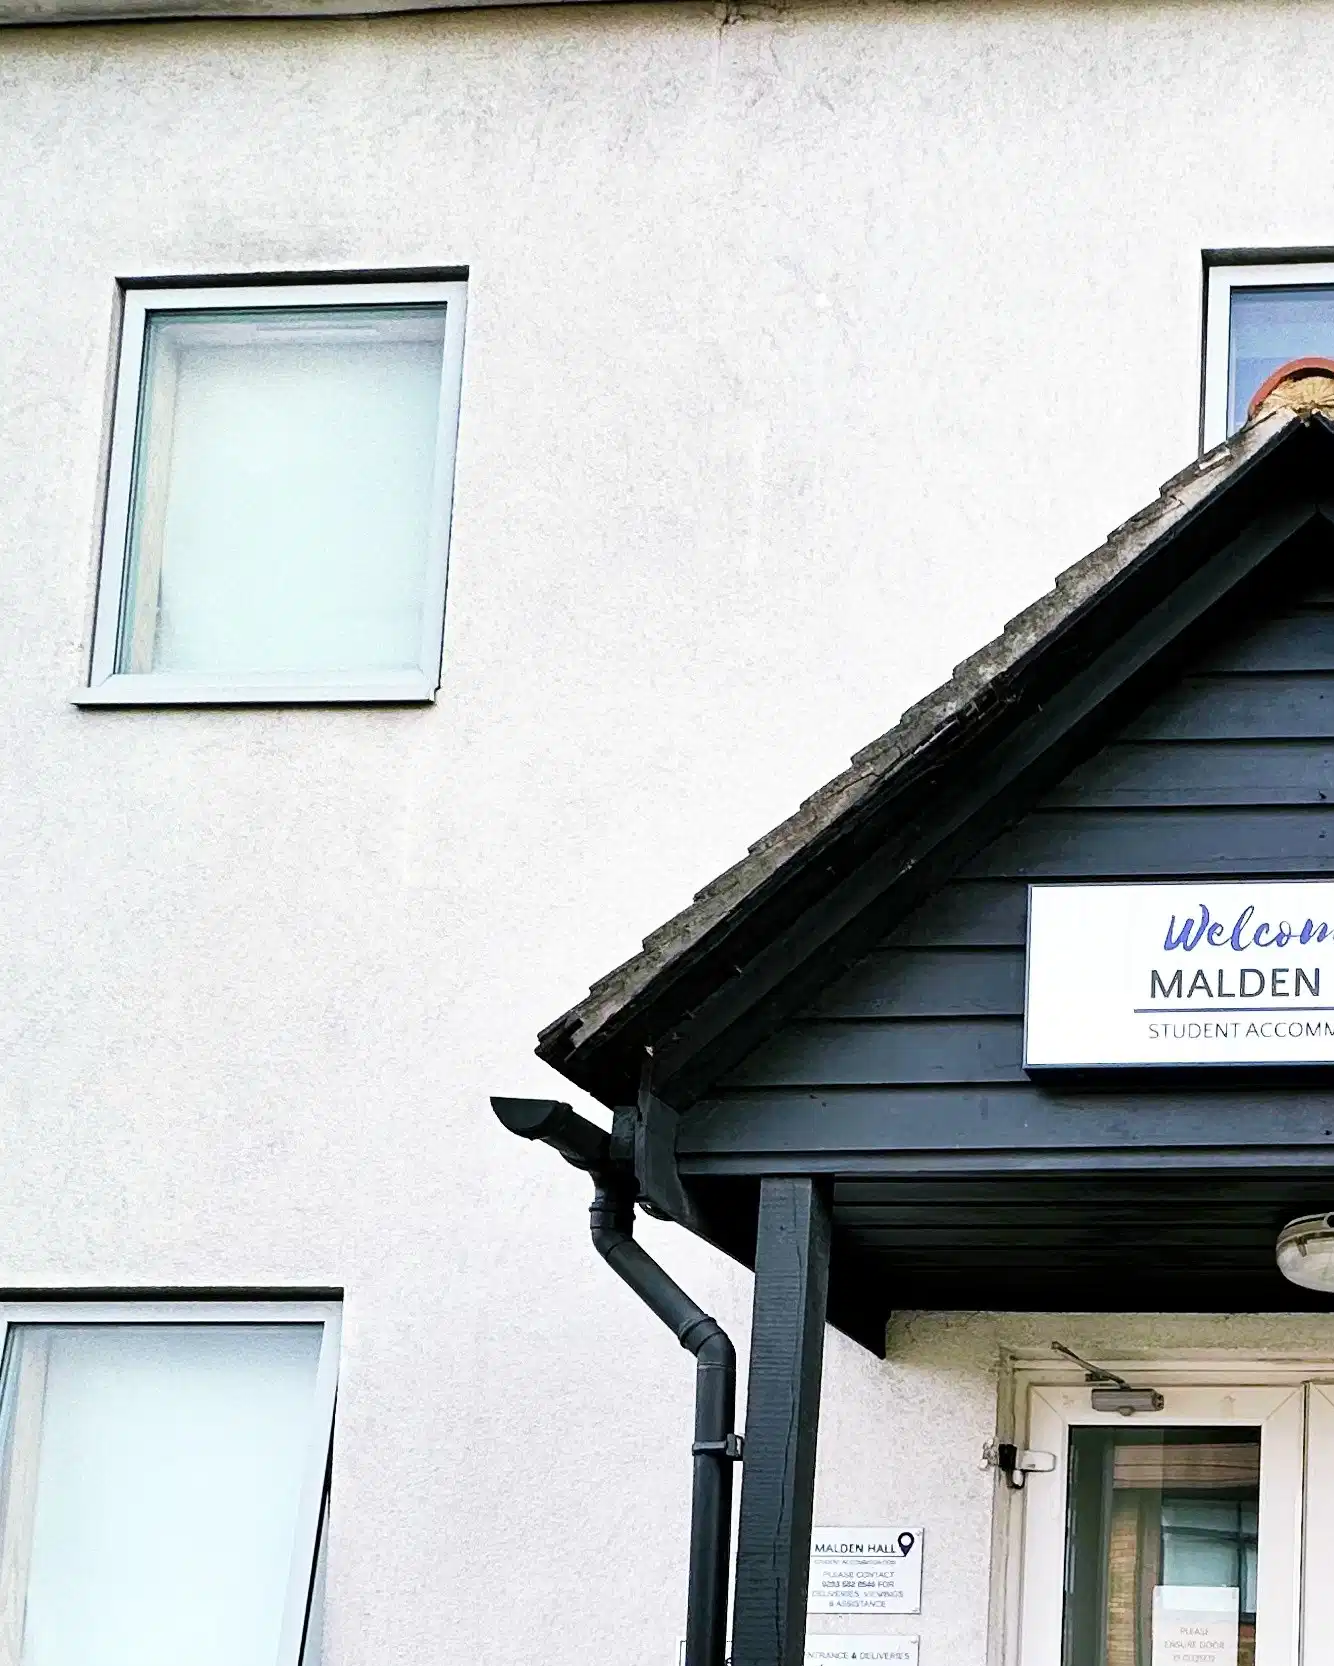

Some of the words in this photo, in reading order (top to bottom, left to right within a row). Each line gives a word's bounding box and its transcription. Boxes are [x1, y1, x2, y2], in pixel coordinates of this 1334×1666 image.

[1151, 967, 1320, 999] MALDEN
[1149, 1022, 1240, 1040] STUDENT
[814, 1543, 864, 1554] MALDEN
[867, 1543, 897, 1554] HALL
